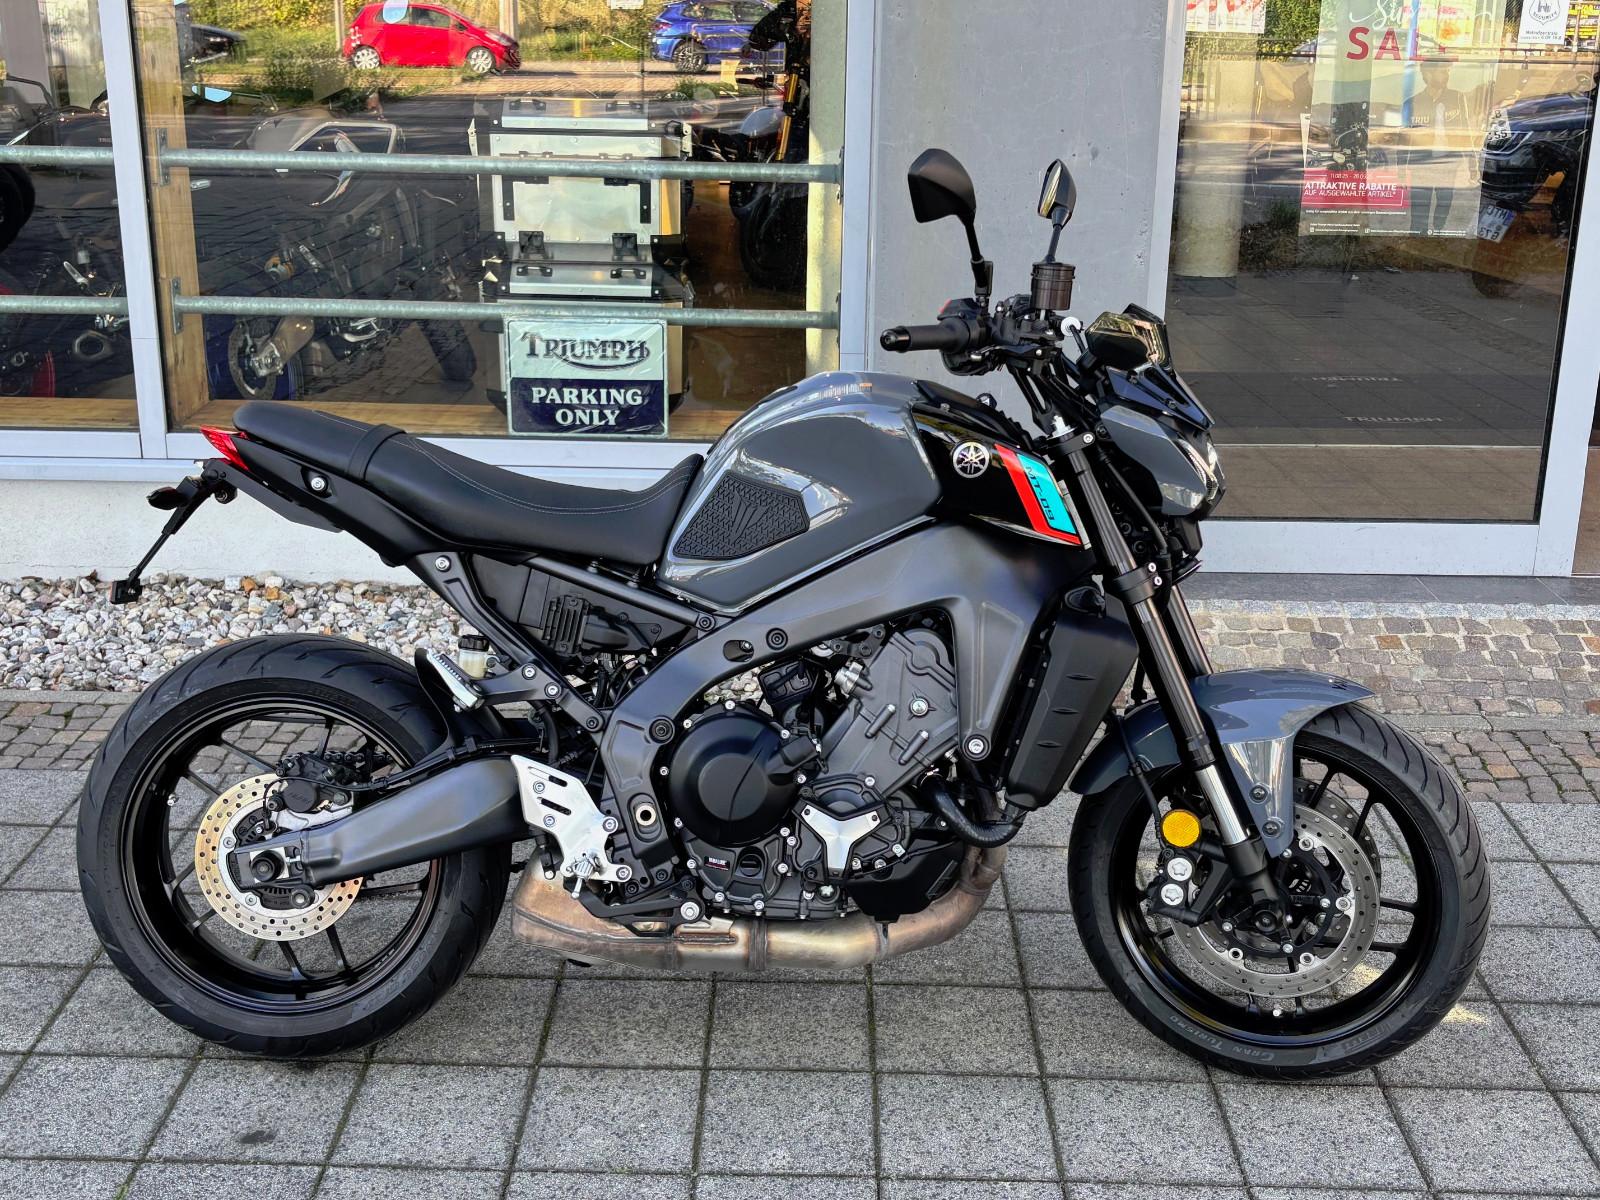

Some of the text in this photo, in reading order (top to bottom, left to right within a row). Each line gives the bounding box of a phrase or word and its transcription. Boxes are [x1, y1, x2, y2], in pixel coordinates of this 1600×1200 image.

[1304, 181, 1397, 191] ATTRAKTIVE RABATTE
[521, 331, 650, 362] TRIUMPH
[531, 387, 643, 406] PARKING
[555, 409, 620, 426] ONLY
[1025, 466, 1055, 521] MT-09
